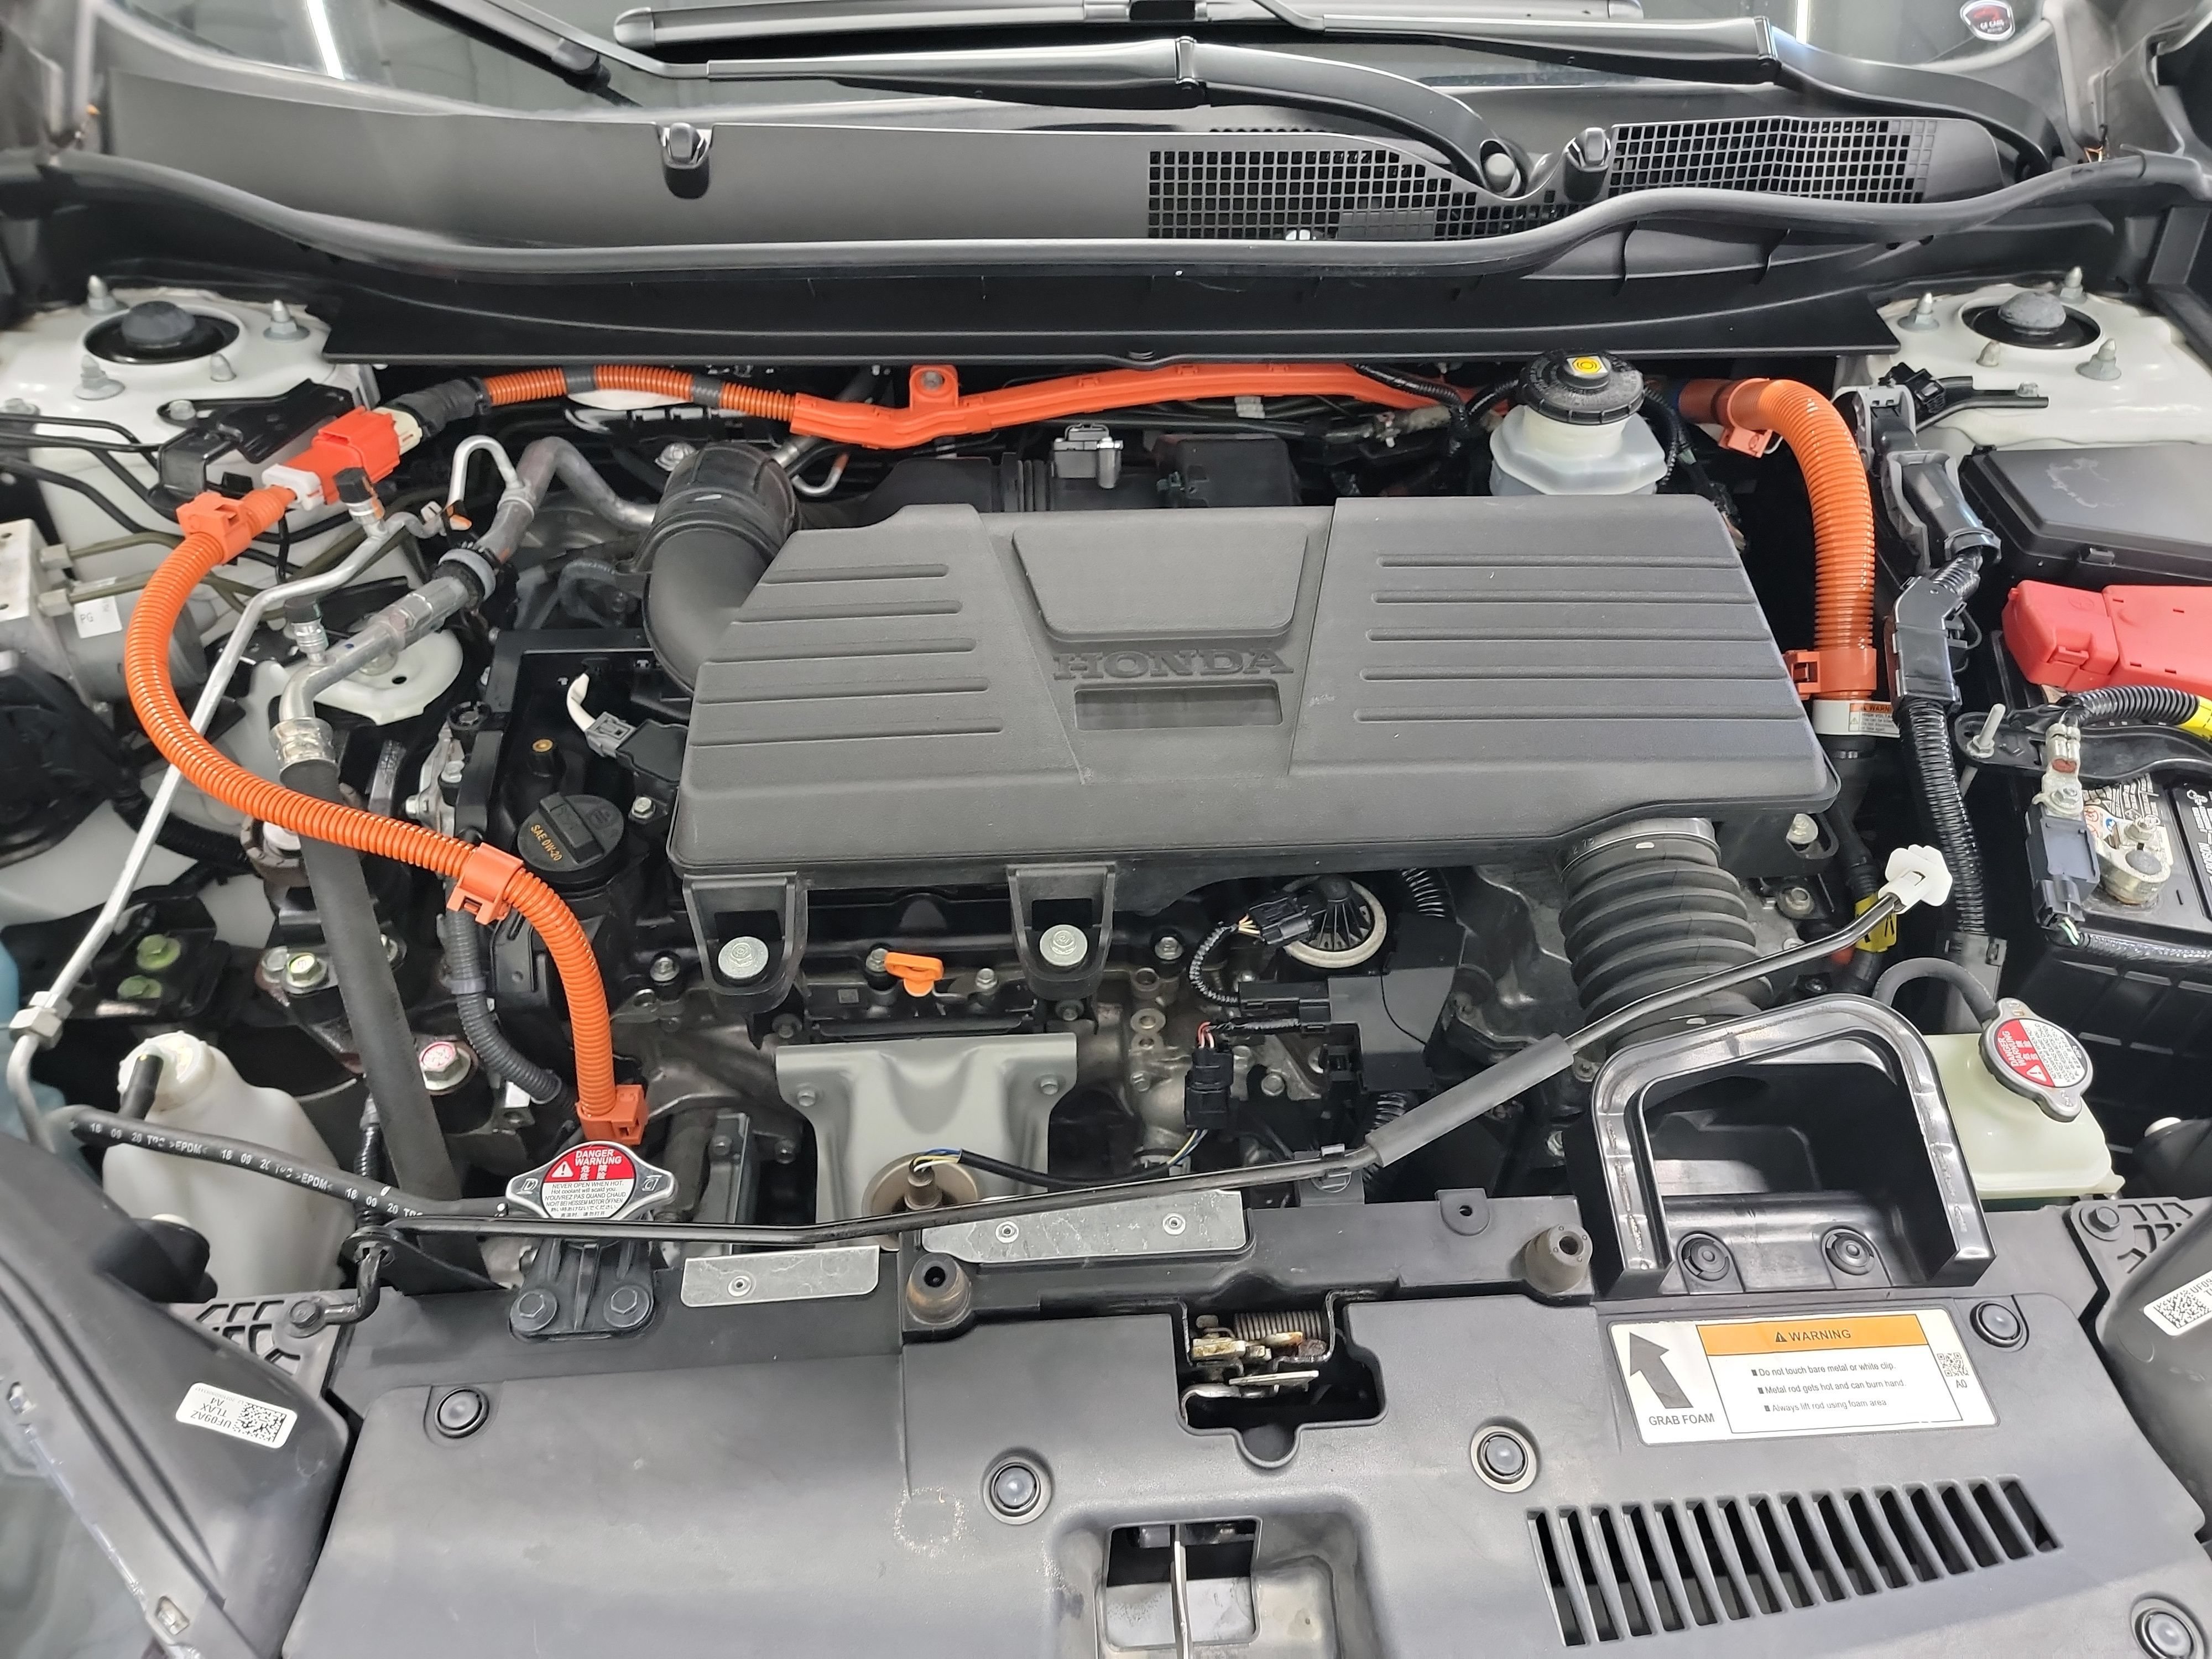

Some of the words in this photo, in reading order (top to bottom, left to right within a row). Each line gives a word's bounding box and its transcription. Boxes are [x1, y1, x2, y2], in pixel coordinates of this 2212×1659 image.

[1052, 649, 1293, 680] HONDA
[531, 825, 547, 841] SAE
[542, 838, 563, 861] 0W-20
[1998, 1036, 2020, 1067] DANGER
[2002, 1031, 2027, 1067] WARNUNG
[576, 1149, 615, 1159] DANGER
[575, 1156, 622, 1166] WARNUNG
[111, 1128, 122, 1140] 09
[132, 1132, 143, 1143] 20
[222, 1149, 233, 1160] 18
[346, 1188, 357, 1199] 18
[366, 1196, 377, 1207] 09
[387, 1203, 398, 1214] 20
[2190, 1276, 2212, 1293] UF09
[1788, 1329, 1851, 1342] WARNING
[1785, 1366, 1807, 1375] touch
[1827, 1364, 1848, 1373] metal
[1859, 1362, 1879, 1371] white
[1881, 1362, 1896, 1371] clip.
[1765, 1385, 1787, 1394] Metal
[1803, 1384, 1819, 1394] gets
[1956, 1380, 1968, 1388] A0
[210, 1397, 225, 1406] A4
[1772, 1404, 1799, 1413] Always
[1827, 1401, 1848, 1410] using
[200, 1403, 227, 1417] TLAX
[190, 1410, 232, 1428] UF09AZ
[1649, 1415, 1680, 1426] GRAB
[1682, 1413, 1714, 1425] FOAM
